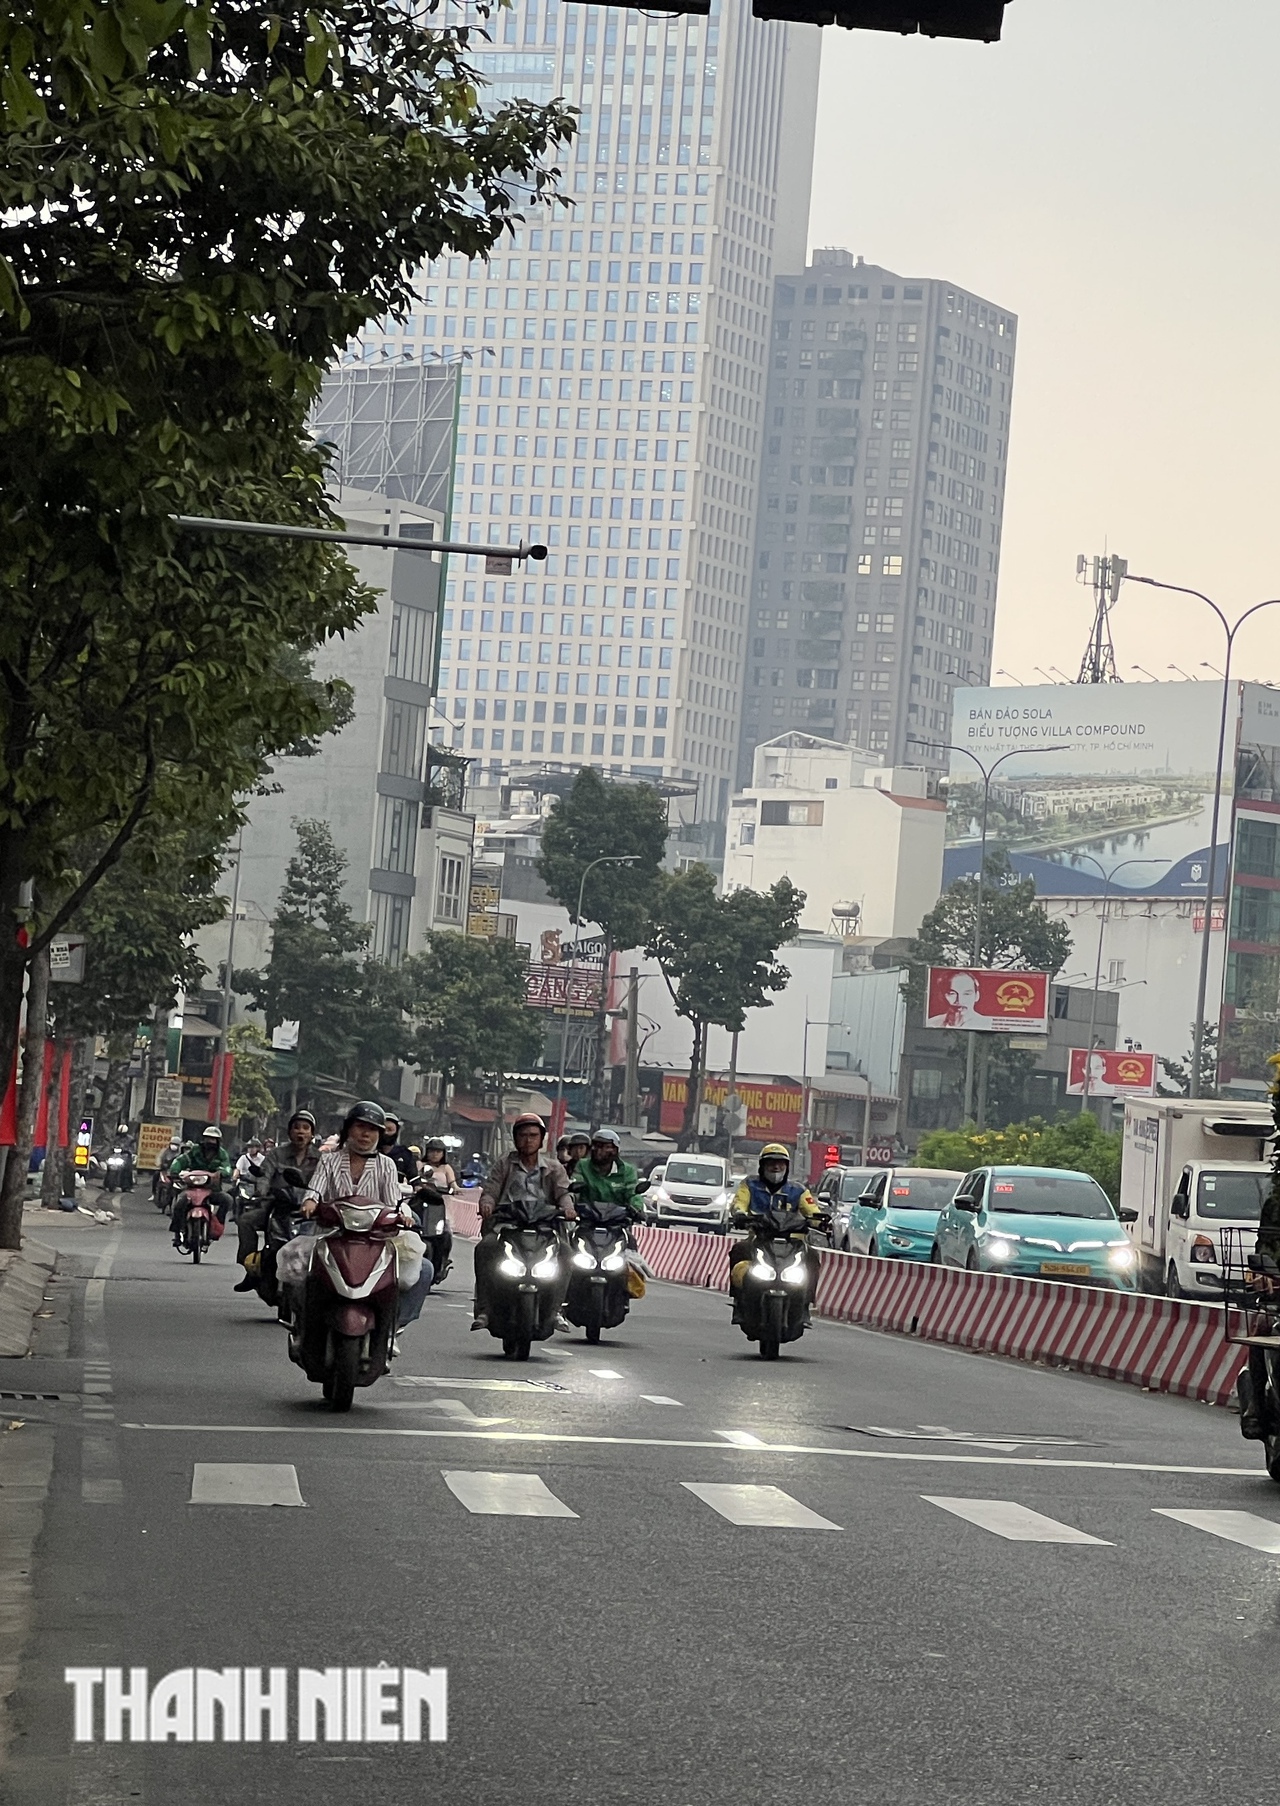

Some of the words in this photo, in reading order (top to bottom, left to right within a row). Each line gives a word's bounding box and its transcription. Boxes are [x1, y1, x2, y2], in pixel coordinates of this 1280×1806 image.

[996, 706, 1019, 719] ĐẢO
[1023, 709, 1052, 719] SOLA
[968, 722, 994, 737] BIỂU
[998, 726, 1038, 739] TƯỢNG
[1041, 726, 1072, 737] VILLA
[1075, 724, 1146, 736] COMPOUND
[1134, 742, 1154, 751] MINH
[663, 1080, 686, 1102] VĂN
